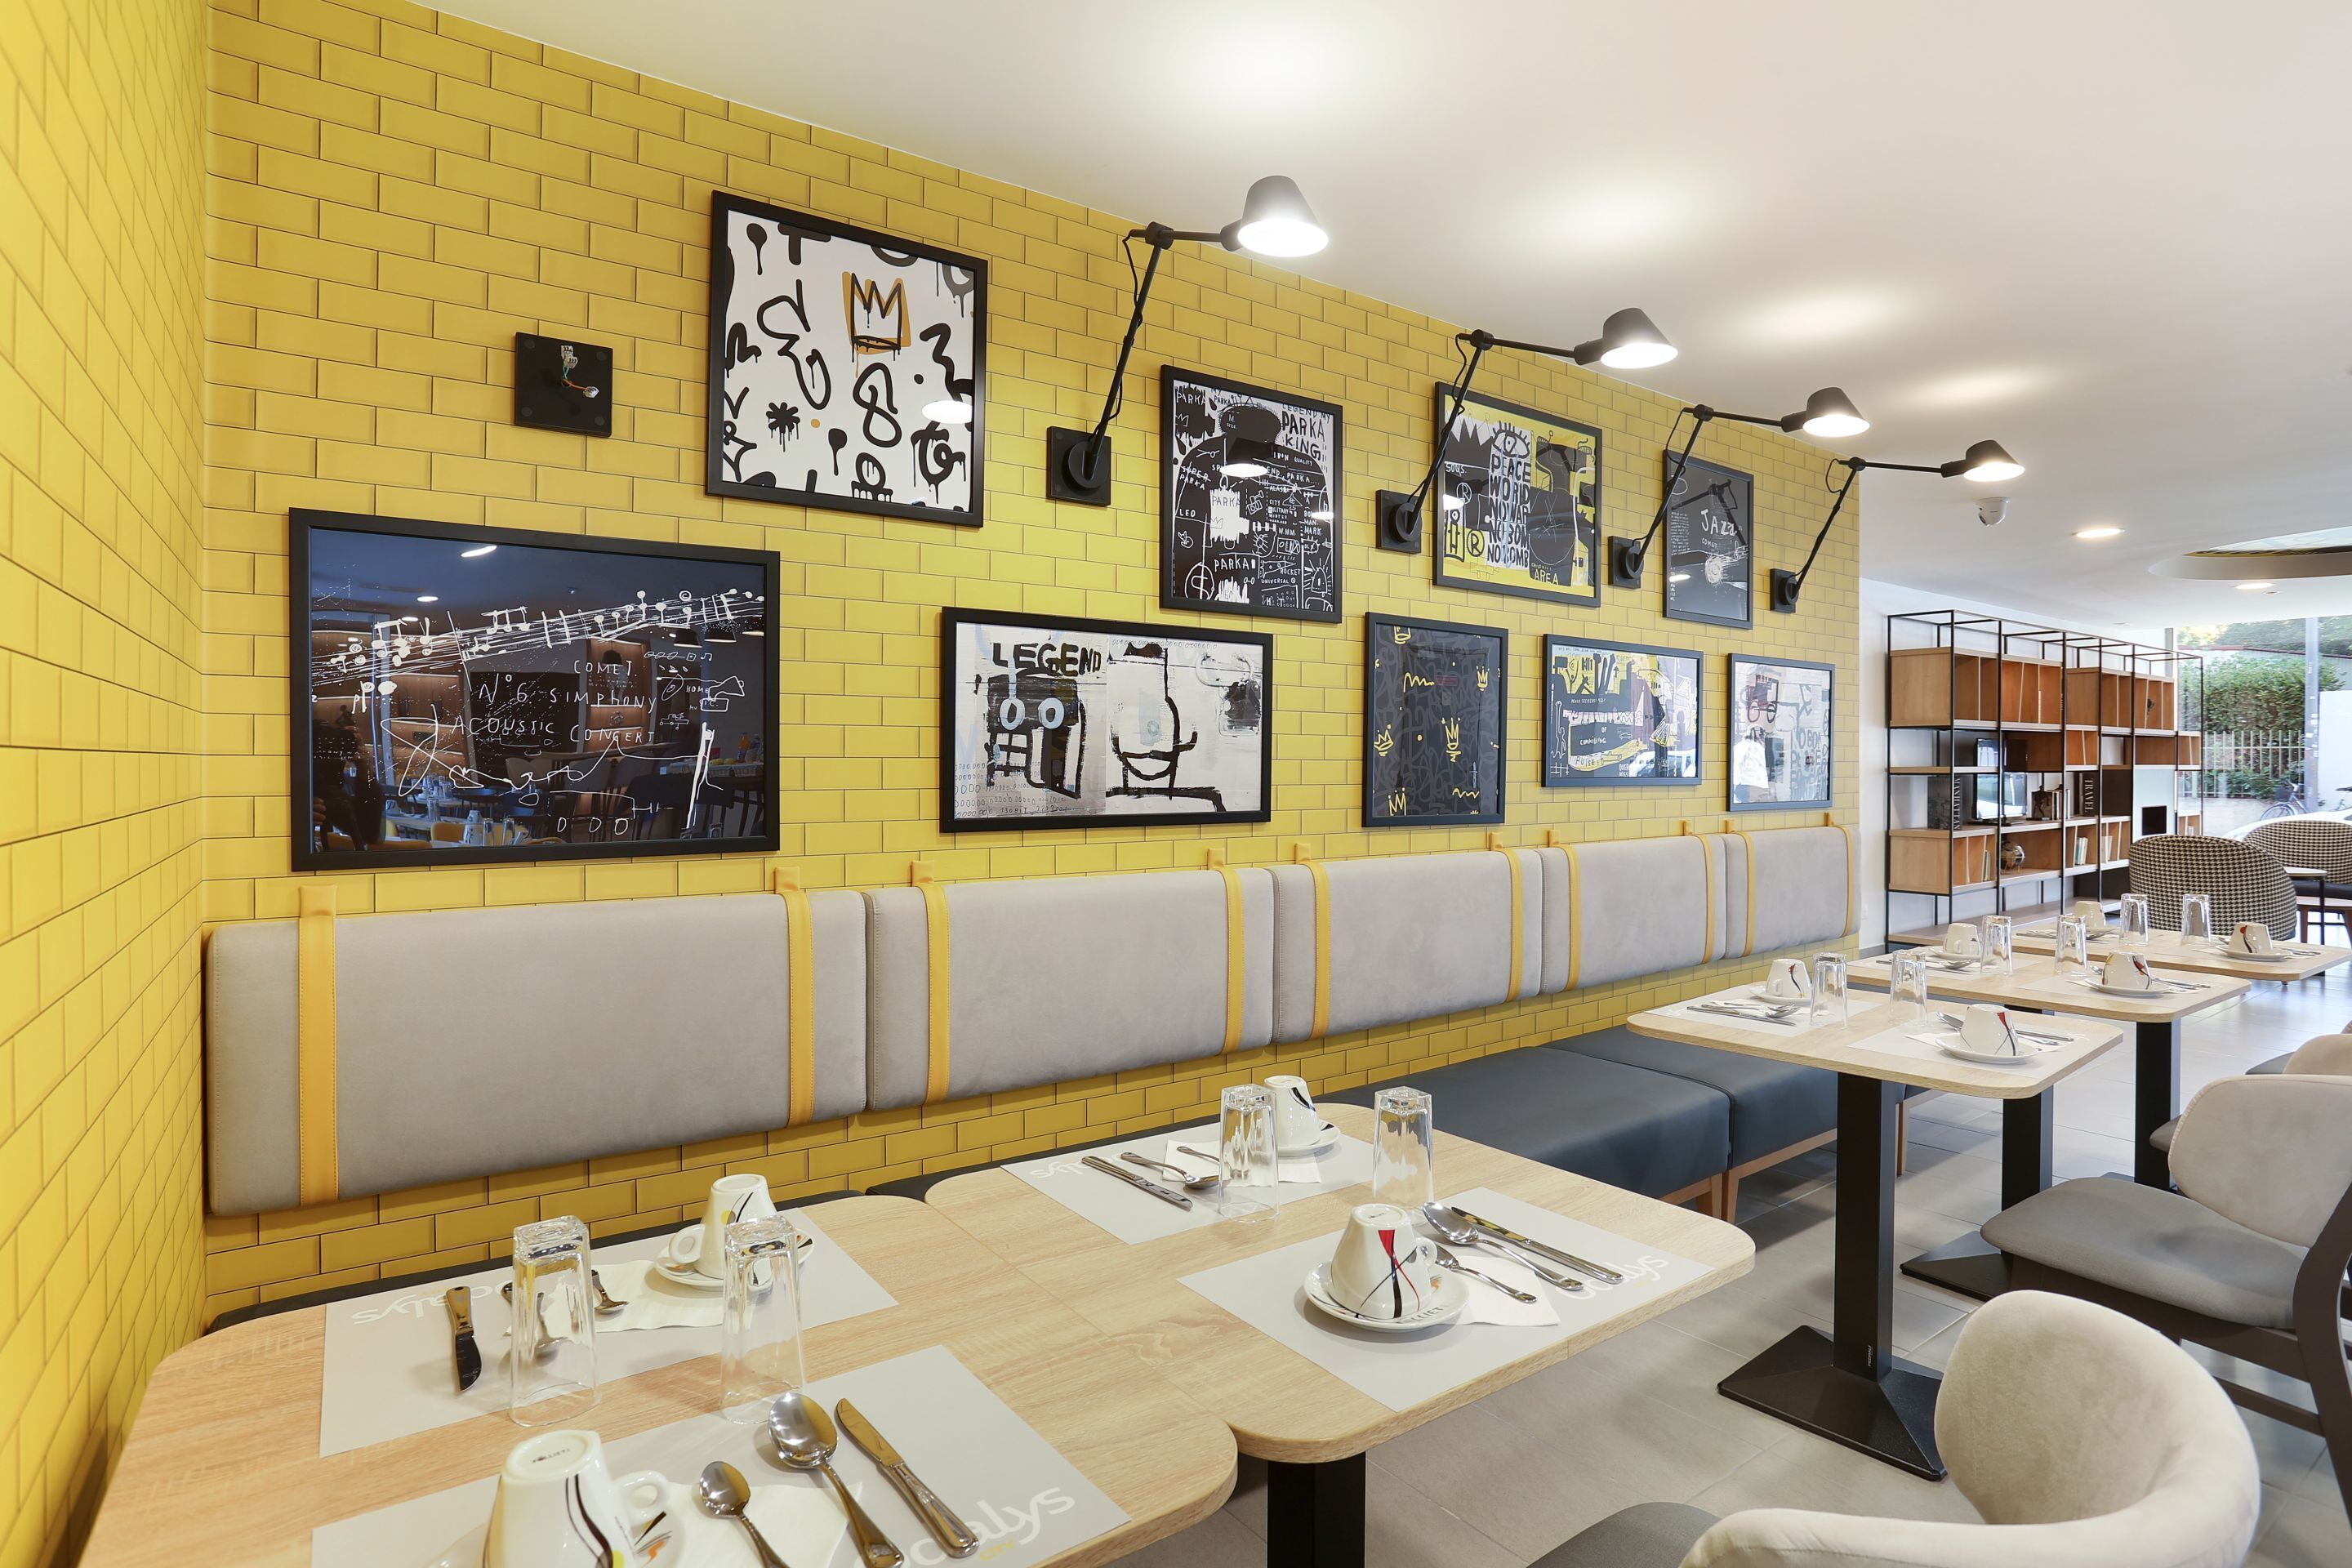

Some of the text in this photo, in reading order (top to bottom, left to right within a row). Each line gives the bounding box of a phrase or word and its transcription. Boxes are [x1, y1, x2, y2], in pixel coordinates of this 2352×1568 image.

[1176, 392, 1206, 405] PARKA
[1214, 395, 1231, 405] PARKA
[1283, 403, 1317, 417] LEGEND
[1282, 410, 1325, 442] PARKA
[1285, 433, 1321, 461] KING
[1294, 457, 1312, 466] QUALITY
[1490, 453, 1531, 483] PEACE
[1179, 474, 1205, 490] PARKA
[1212, 496, 1240, 507] PARKA
[1179, 508, 1196, 517] LEO
[1700, 509, 1737, 537] JAZZ
[1214, 558, 1250, 572] PARKA
[1535, 568, 1559, 586] AREA
[993, 643, 1102, 676] LEGEND
[517, 683, 528, 702] 6
[686, 685, 709, 693] HOME
[2084, 778, 2094, 811] TRAVEL
